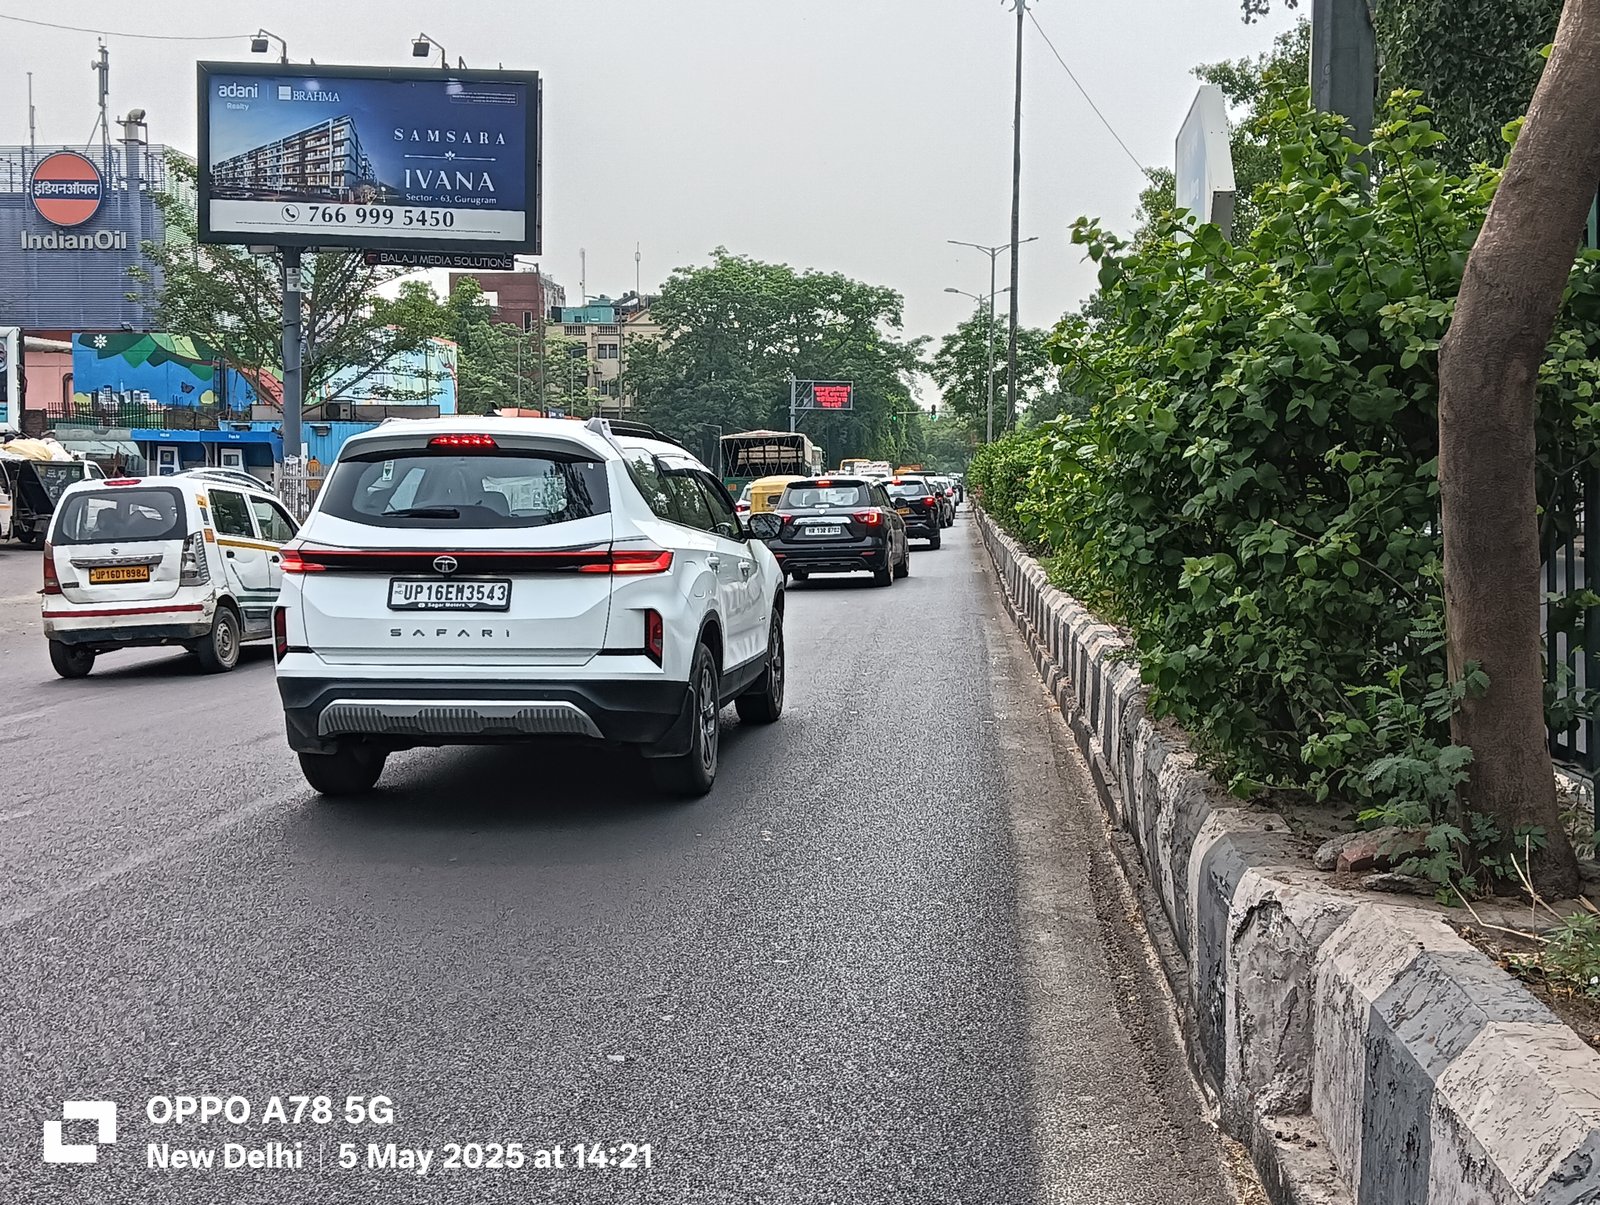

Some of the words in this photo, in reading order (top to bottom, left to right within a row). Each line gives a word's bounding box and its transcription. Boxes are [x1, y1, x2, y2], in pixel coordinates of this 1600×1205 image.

[218, 82, 259, 98] adani
[293, 90, 340, 102] BRAHMA
[226, 102, 250, 111] Realty
[393, 128, 506, 145] SAMSARA
[404, 169, 496, 192] IVANA
[34, 181, 98, 196] इंडियनऑयल
[405, 192, 433, 203] Sector
[440, 194, 453, 204] 63,
[454, 195, 497, 206] Gurugram
[308, 206, 348, 223] 766
[355, 207, 395, 225] 999
[402, 209, 455, 227] 5450
[20, 230, 128, 250] IndianOil
[380, 252, 418, 265] BALAJI
[419, 254, 453, 266] MEDIA
[453, 255, 513, 269] SOLUTIONS
[95, 568, 148, 581] UP16DT8984
[389, 628, 510, 638] SAFARI
